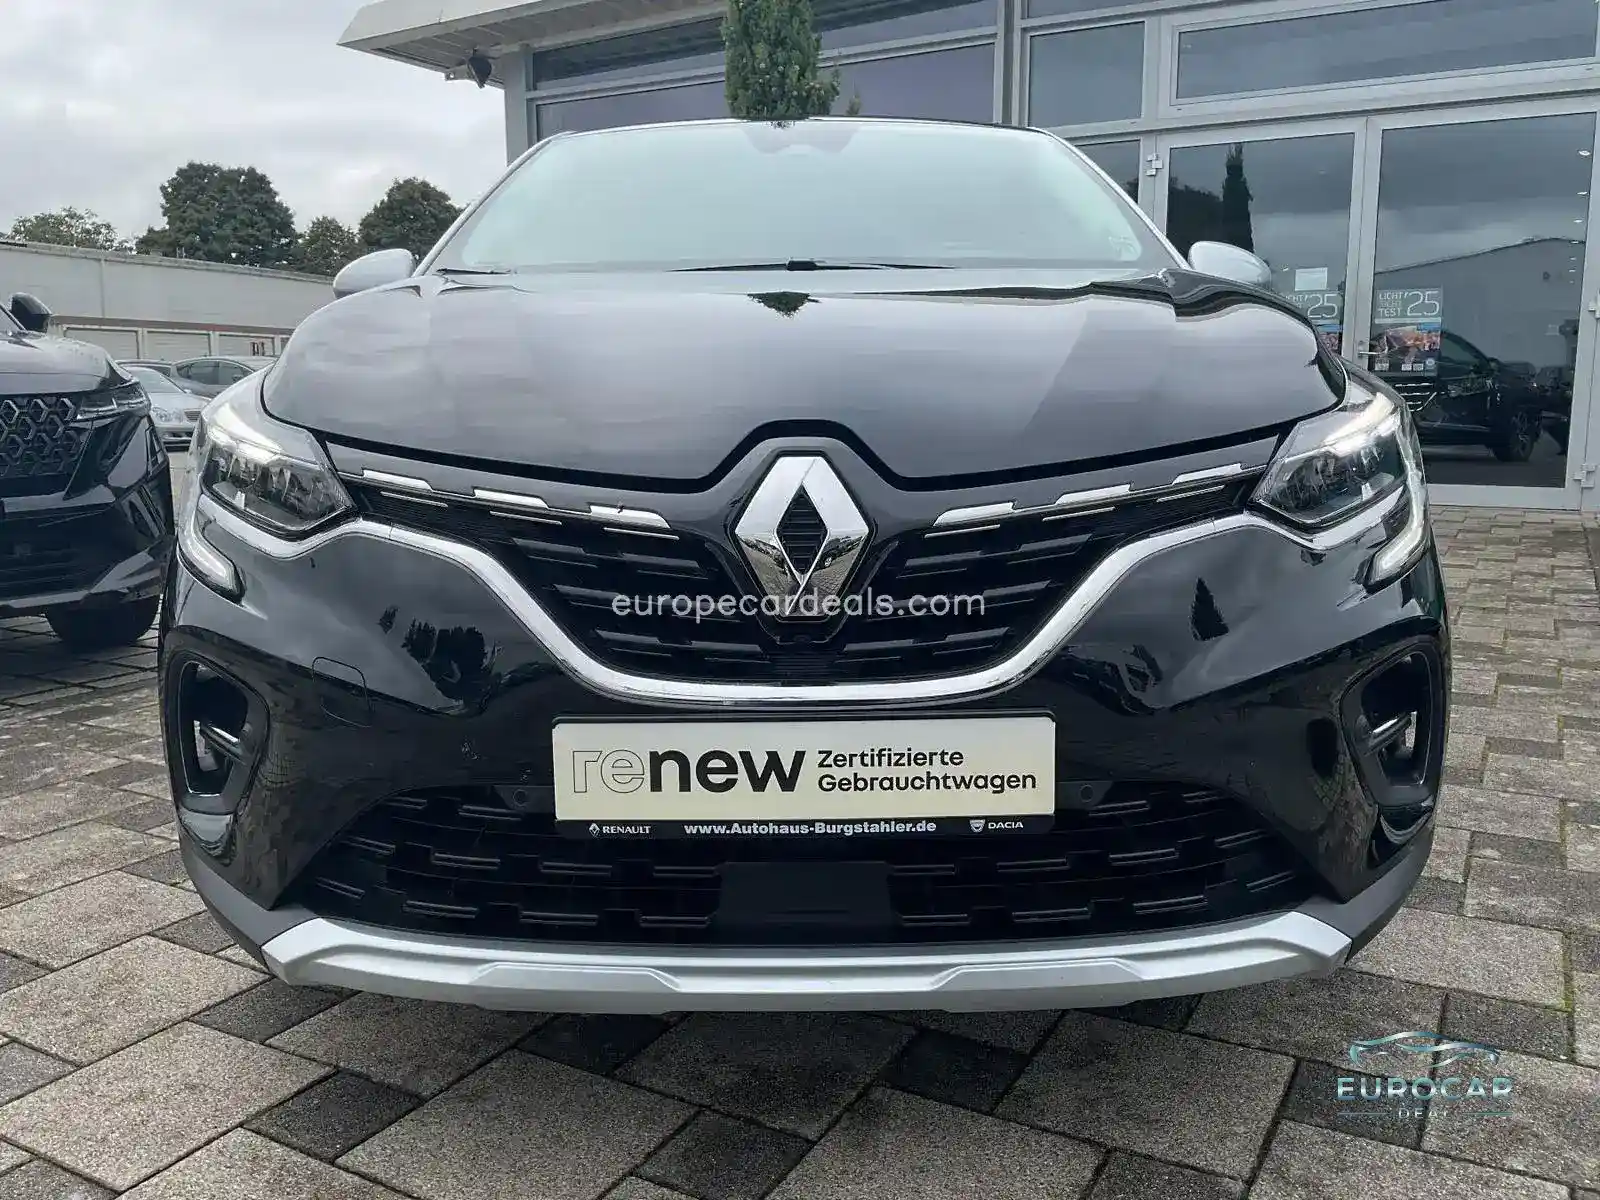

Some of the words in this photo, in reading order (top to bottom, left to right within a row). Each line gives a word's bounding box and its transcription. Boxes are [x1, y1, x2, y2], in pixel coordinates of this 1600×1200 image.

[1378, 308, 1401, 316] TEST
[817, 748, 965, 769] Zertifizierte
[573, 749, 807, 794] renew
[817, 770, 1037, 794] Gebrauchtwagen
[602, 824, 652, 836] RENAULT
[684, 821, 938, 837] www.Autohaus-Burgstahler.de
[987, 820, 1025, 831] DACIA
